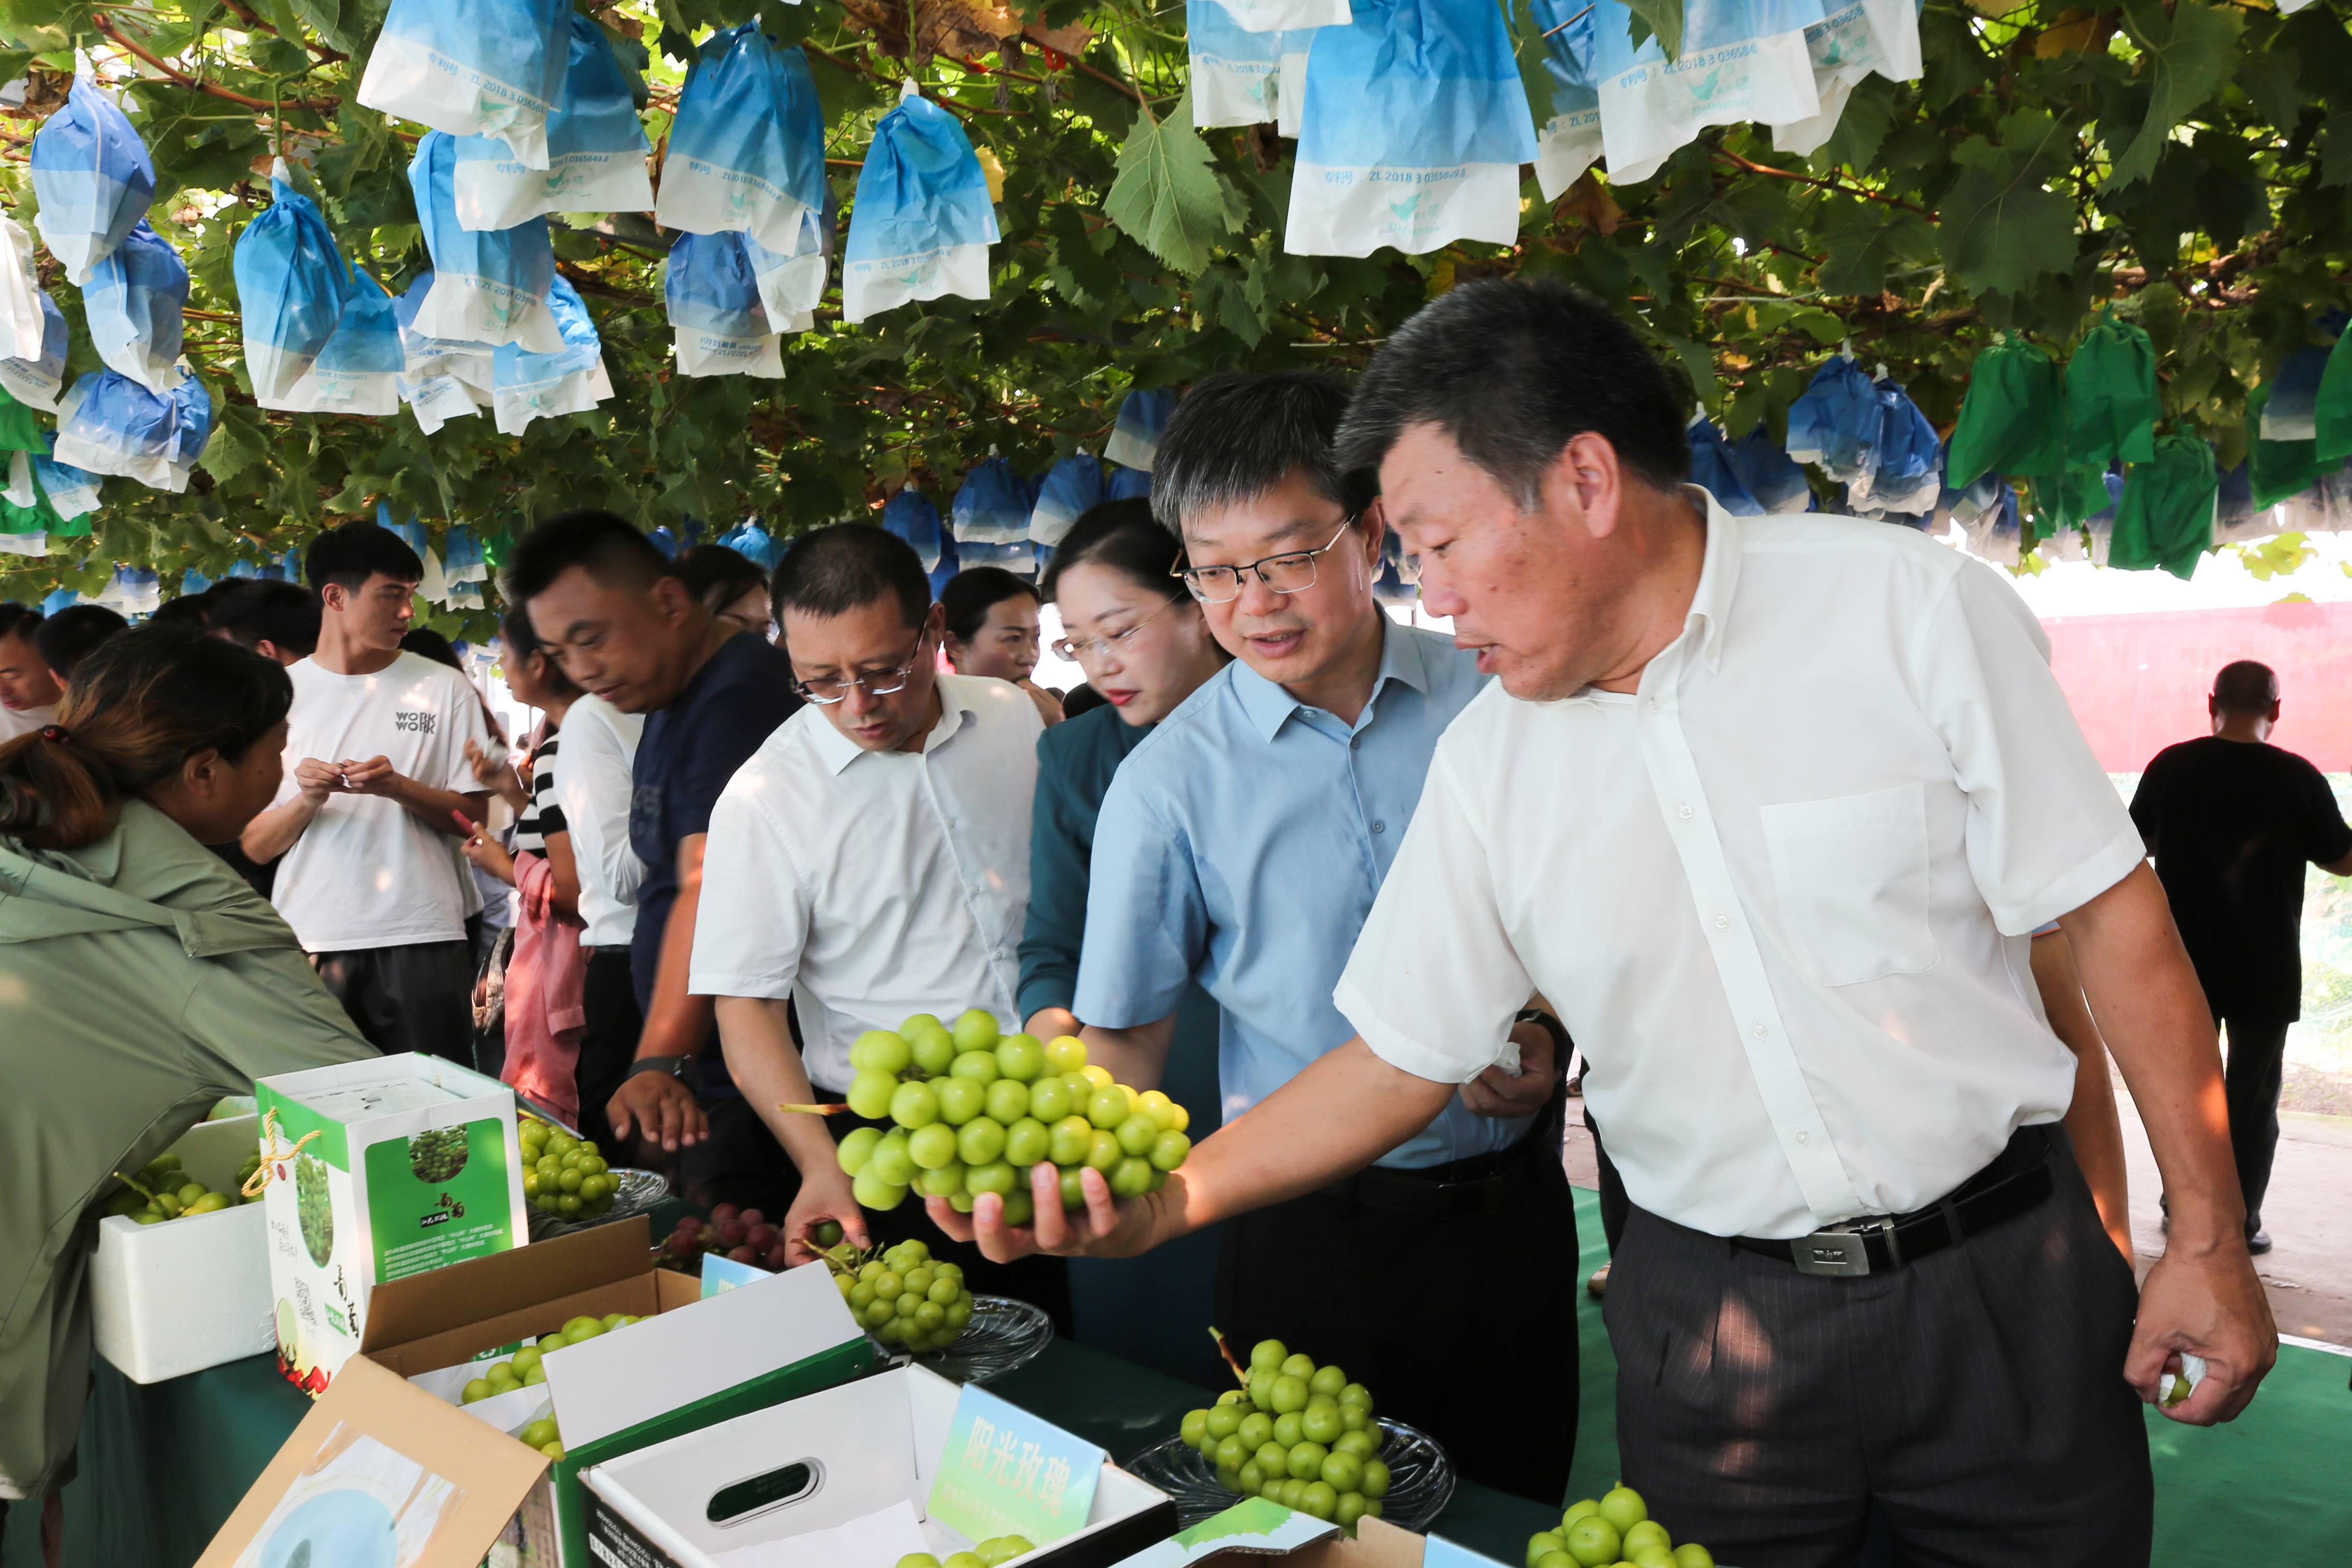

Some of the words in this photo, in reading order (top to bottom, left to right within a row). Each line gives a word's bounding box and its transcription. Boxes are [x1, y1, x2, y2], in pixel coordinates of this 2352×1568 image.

[483, 80, 507, 97] 2018
[510, 91, 515, 100] 3
[1369, 171, 1382, 182] ZL
[1385, 171, 1412, 182] 2018
[1416, 172, 1421, 184] 3
[396, 712, 437, 724] WORK
[396, 721, 435, 734] WORK
[962, 1415, 1071, 1517] 阳光玫瑰
